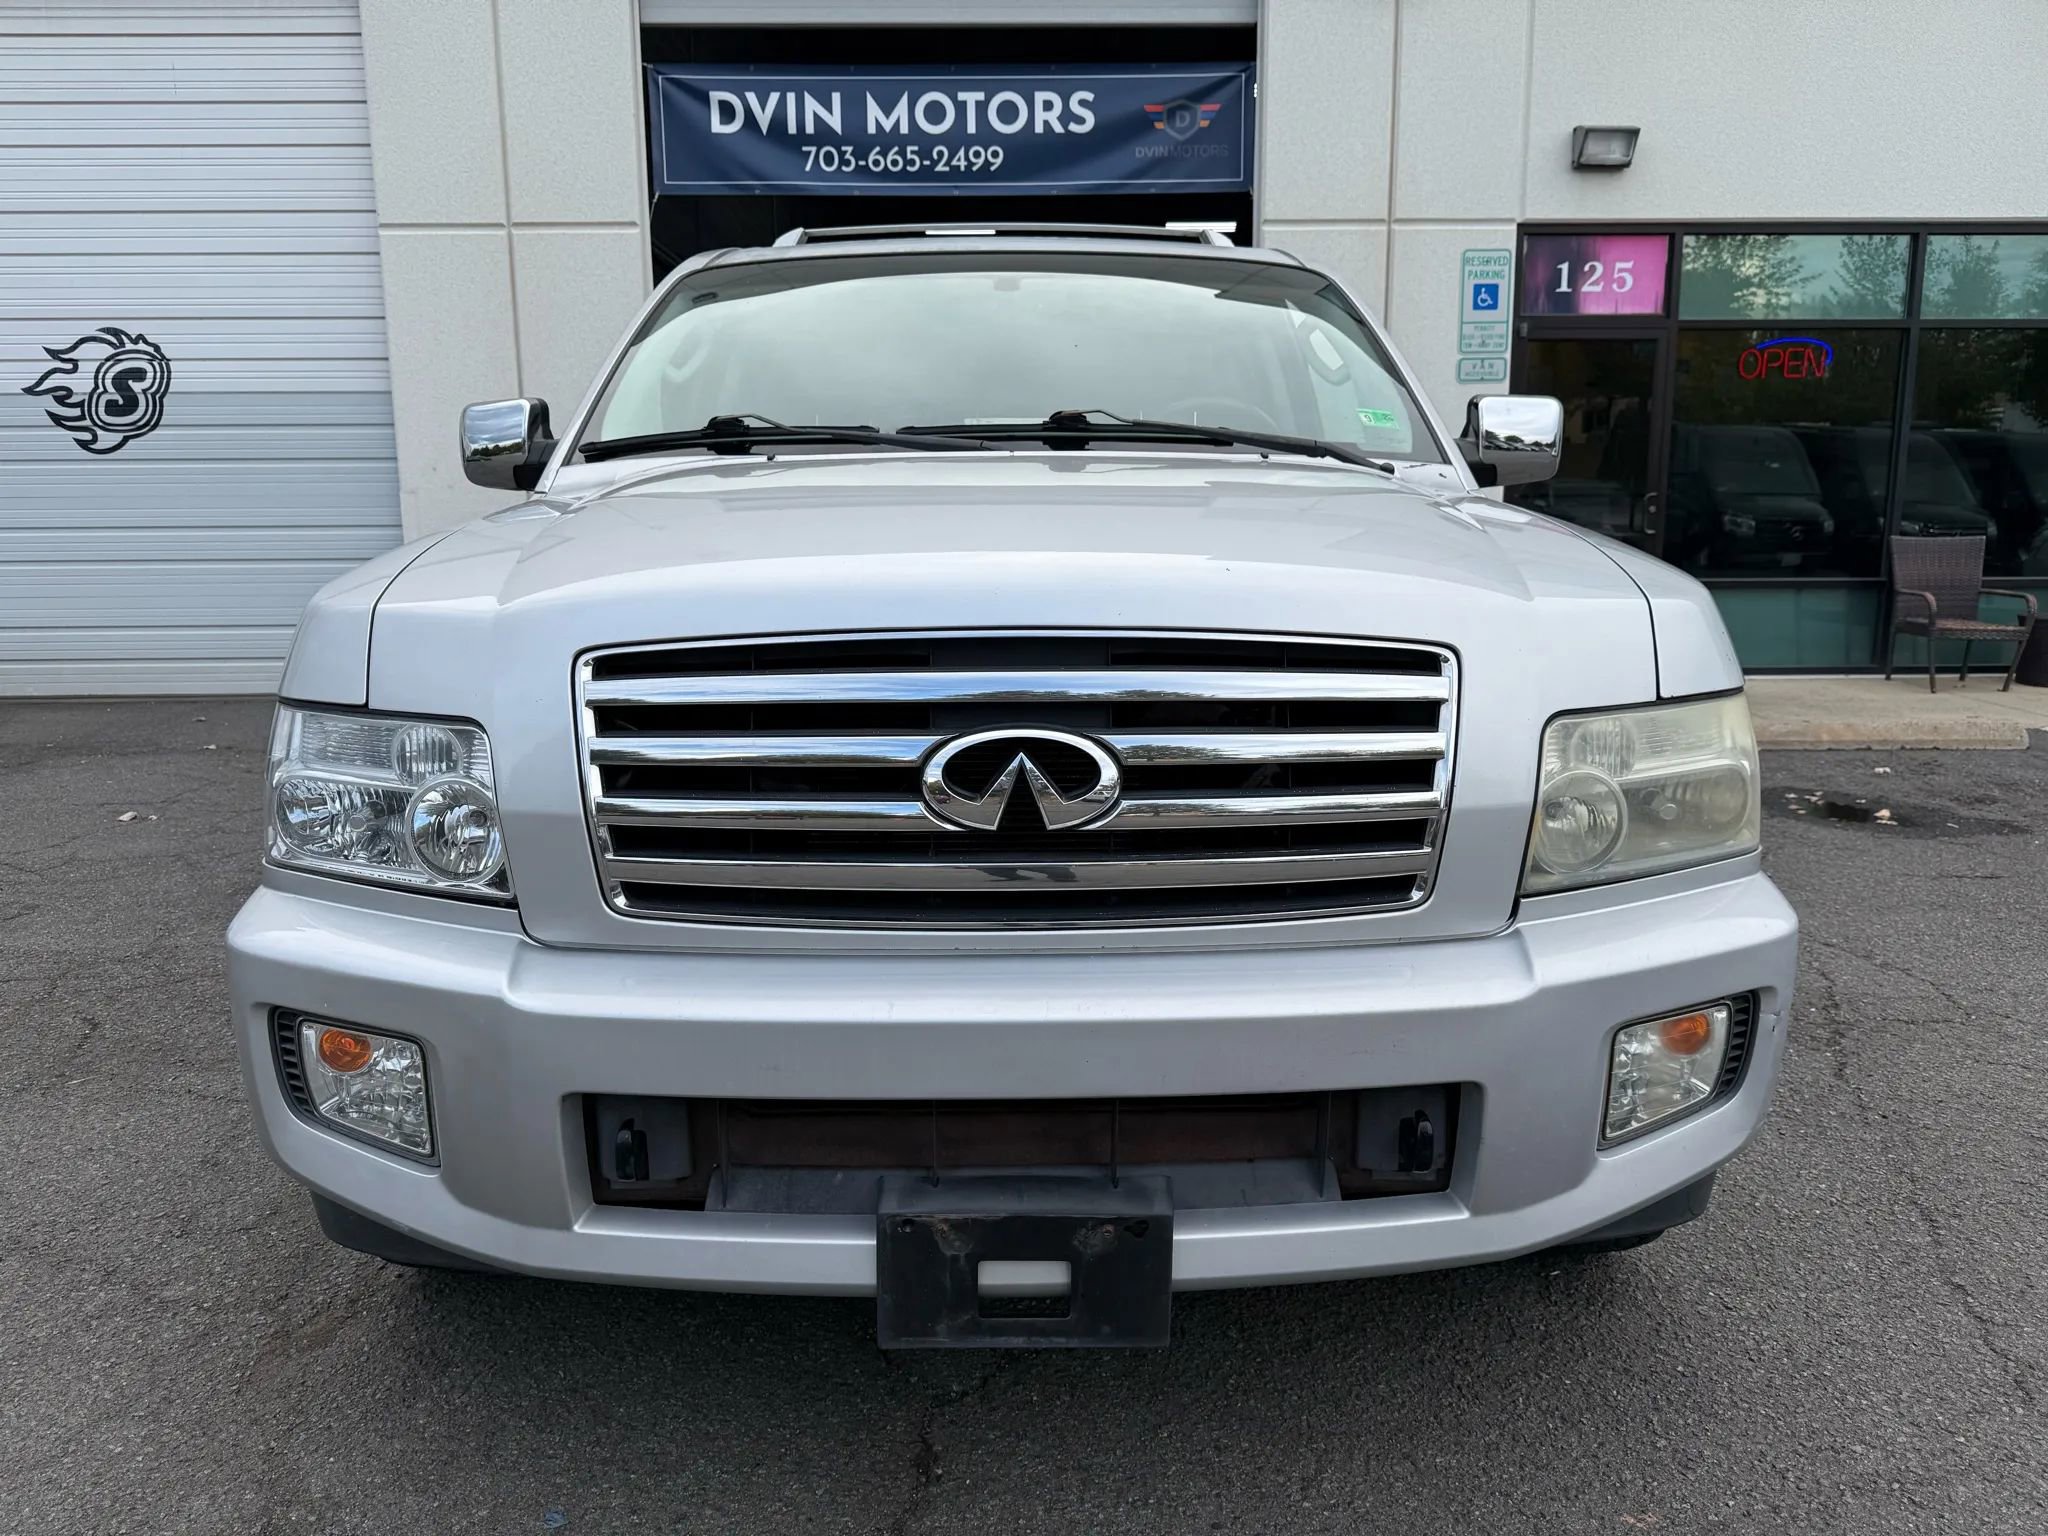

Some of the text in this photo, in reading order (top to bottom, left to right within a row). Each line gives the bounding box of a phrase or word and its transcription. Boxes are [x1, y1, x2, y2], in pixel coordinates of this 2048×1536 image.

[709, 91, 1095, 135] DVIN MOTORS
[1175, 110, 1191, 127] D
[801, 146, 1004, 174] 703-665-2499
[1465, 255, 1509, 267] RESERVED
[1468, 270, 1505, 280] PARKING
[1555, 260, 1634, 293] 125
[1739, 347, 1828, 379] OPEN
